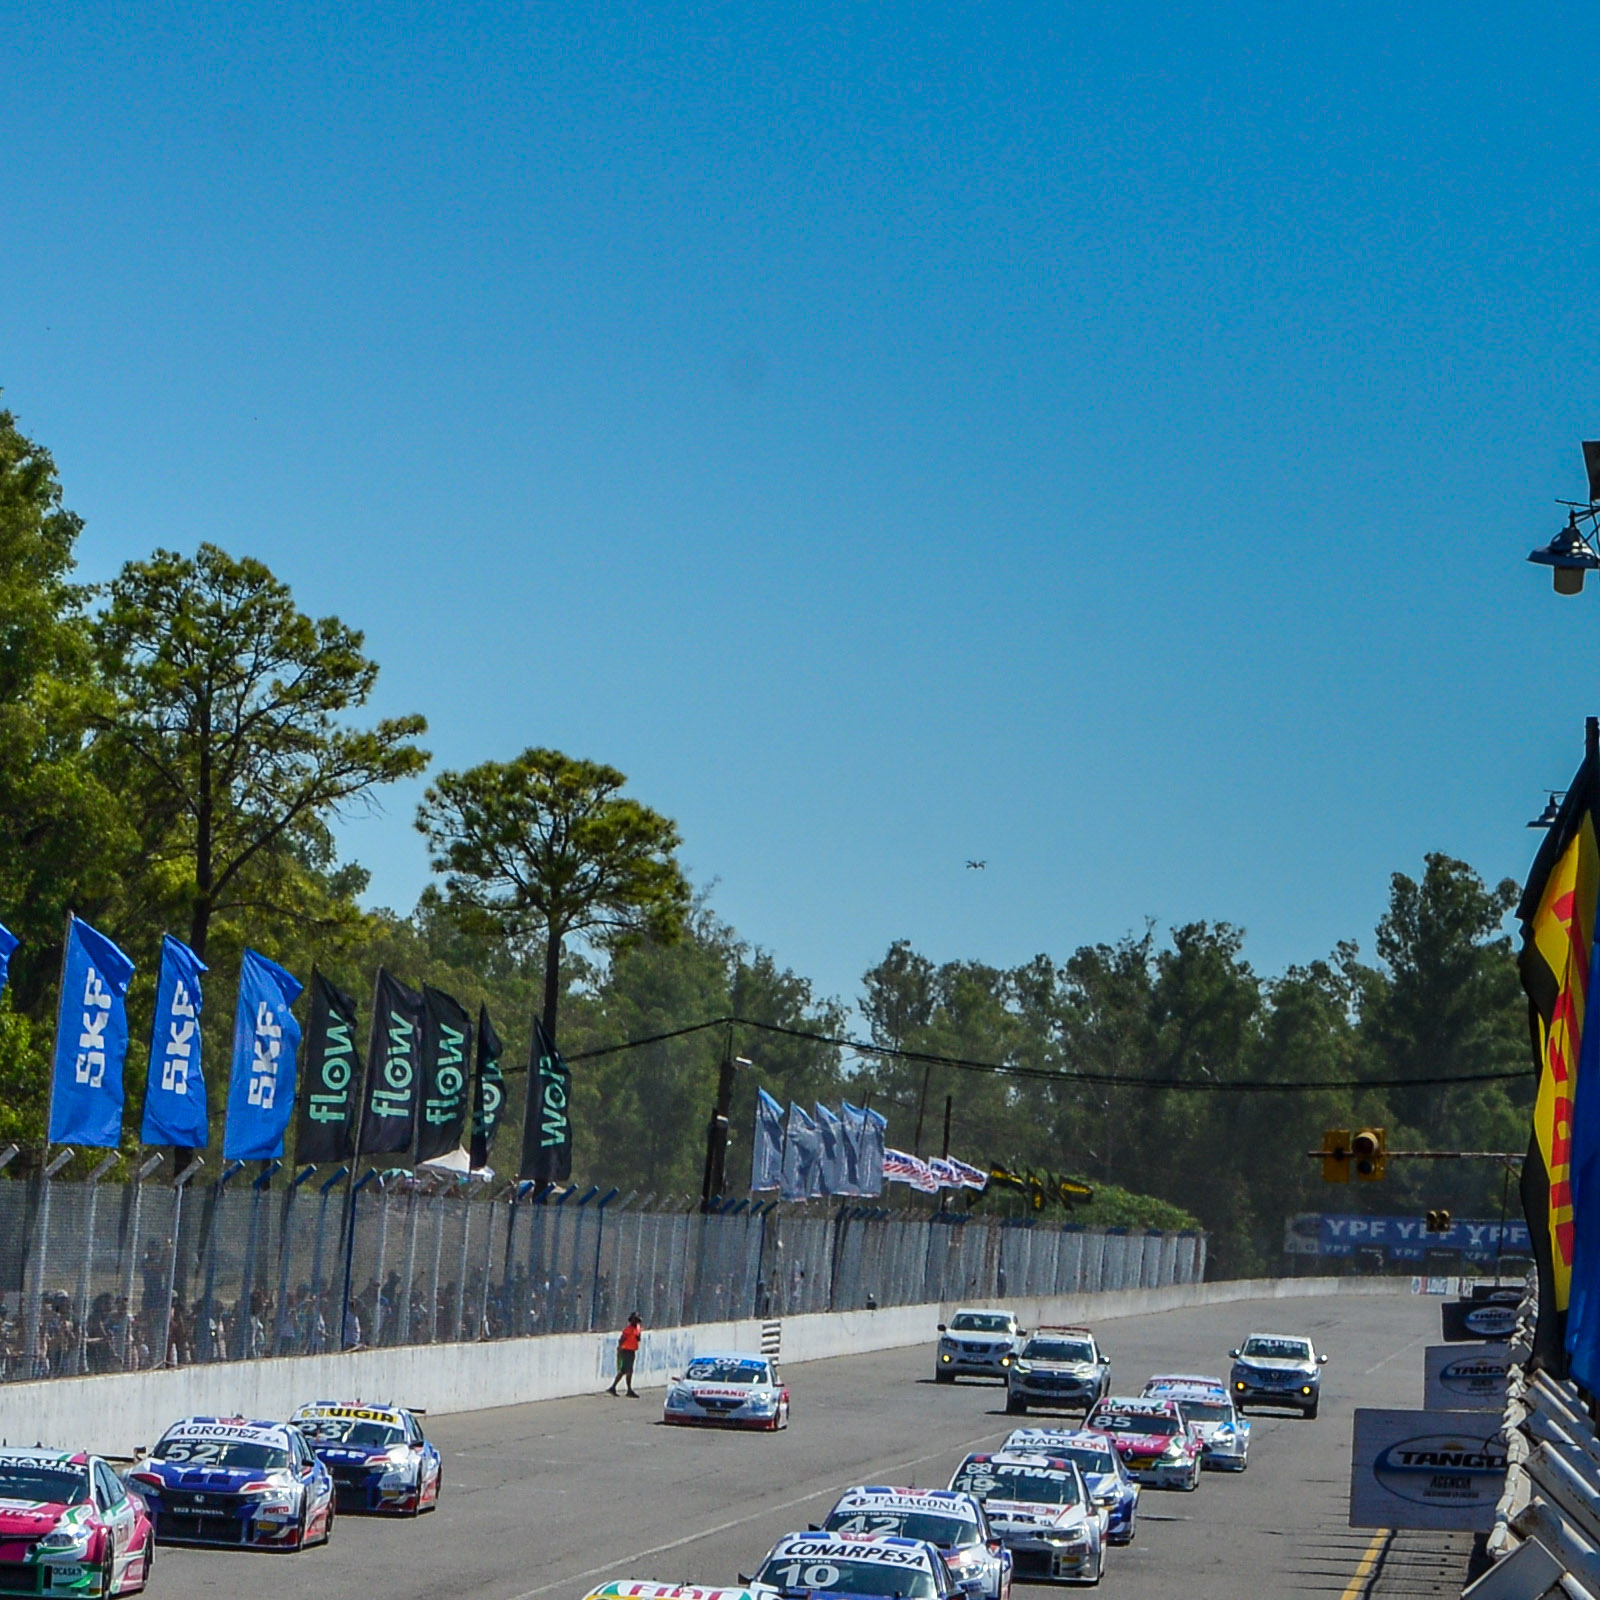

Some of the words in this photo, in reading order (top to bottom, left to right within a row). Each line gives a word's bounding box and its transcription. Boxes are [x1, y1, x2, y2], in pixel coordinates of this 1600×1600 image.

[75, 967, 112, 1088] SKF
[161, 980, 195, 1095] SKF
[248, 1001, 284, 1109] SKF
[371, 1010, 413, 1119] flow
[309, 1009, 354, 1124] flow
[425, 1023, 465, 1125] flow
[1325, 1219, 1387, 1238] YPF
[1466, 1224, 1528, 1244] YPF
[1451, 1366, 1506, 1376] TANG
[1100, 1405, 1153, 1415] OCASA
[174, 1425, 262, 1439] AGROPEZ
[1093, 1416, 1132, 1428] 85
[164, 1443, 221, 1463] 52
[1010, 1437, 1107, 1451] PRADECON
[171, 1466, 253, 1476] YPF
[956, 1478, 996, 1492] 19
[874, 1496, 968, 1513] PATAGONIA
[837, 1515, 902, 1536] 42
[784, 1542, 926, 1567] CONARPESA
[775, 1564, 840, 1588] 10
